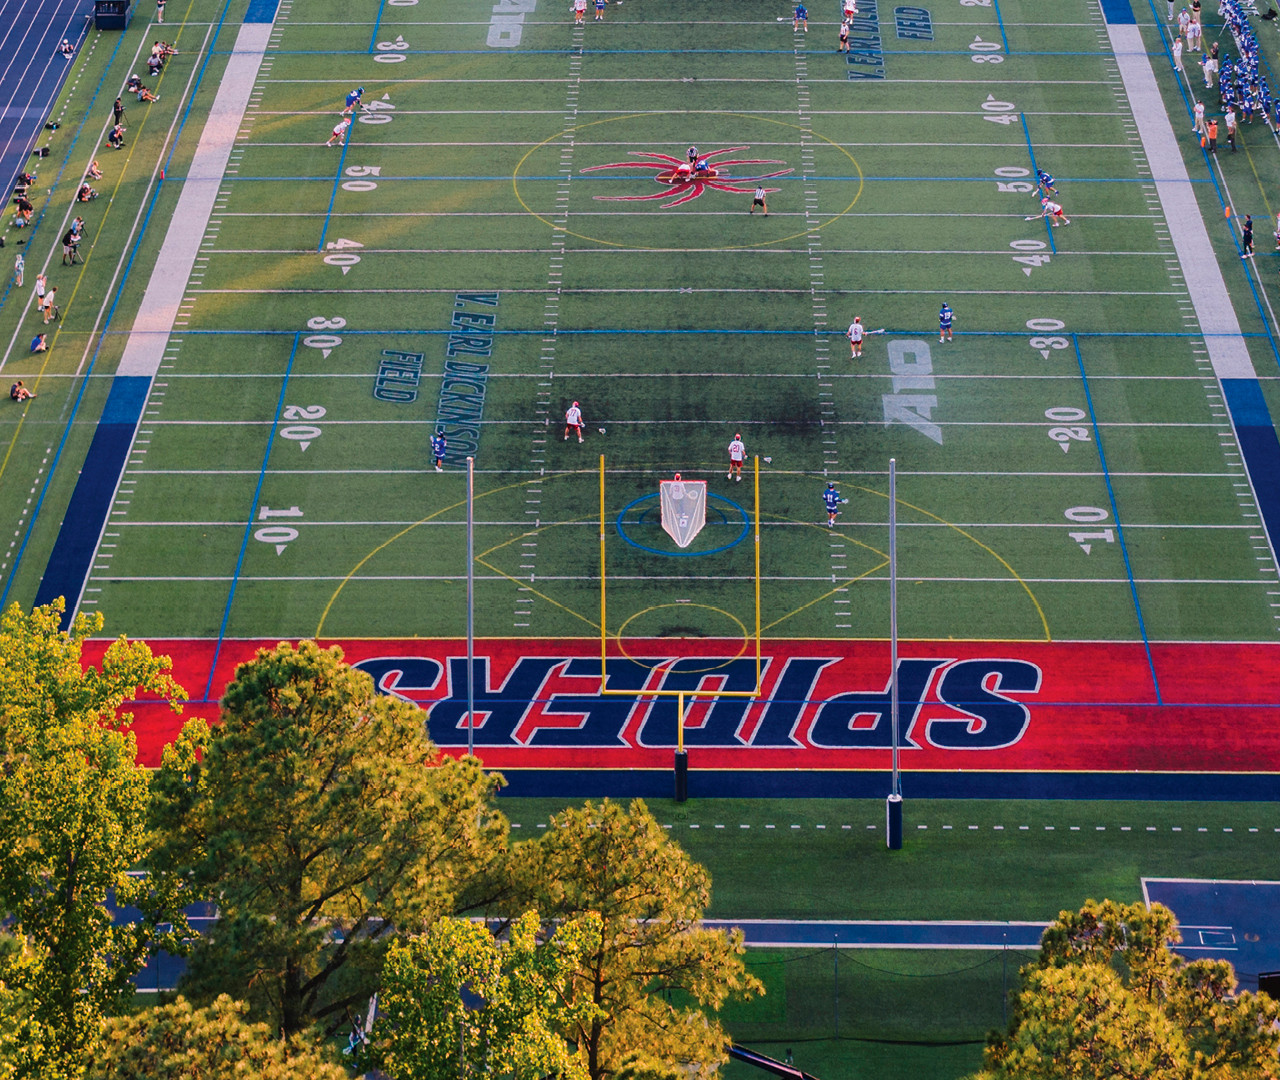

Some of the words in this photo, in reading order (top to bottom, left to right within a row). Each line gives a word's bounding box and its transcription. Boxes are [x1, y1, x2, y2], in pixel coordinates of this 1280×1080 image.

[894, 6, 935, 41] FIELD
[373, 41, 410, 63] 30
[845, 34, 884, 67] EARL
[968, 41, 1005, 64] 30
[847, 68, 886, 81] V.
[358, 100, 396, 124] 40
[981, 100, 1018, 125] 40
[341, 165, 381, 192] 50
[994, 166, 1034, 193] 50
[323, 238, 364, 266] 40
[1009, 239, 1051, 267] 40
[454, 292, 499, 307] V.
[303, 316, 347, 348] 30
[447, 310, 496, 357] EARL
[1026, 318, 1069, 350] 30
[372, 349, 425, 403] FIELD
[279, 405, 327, 440] 20
[431, 360, 490, 469] DICKINSON
[1044, 406, 1092, 442] 20
[254, 506, 304, 543] 10
[1064, 506, 1115, 543] 10
[348, 655, 1043, 751] SPIDERS
